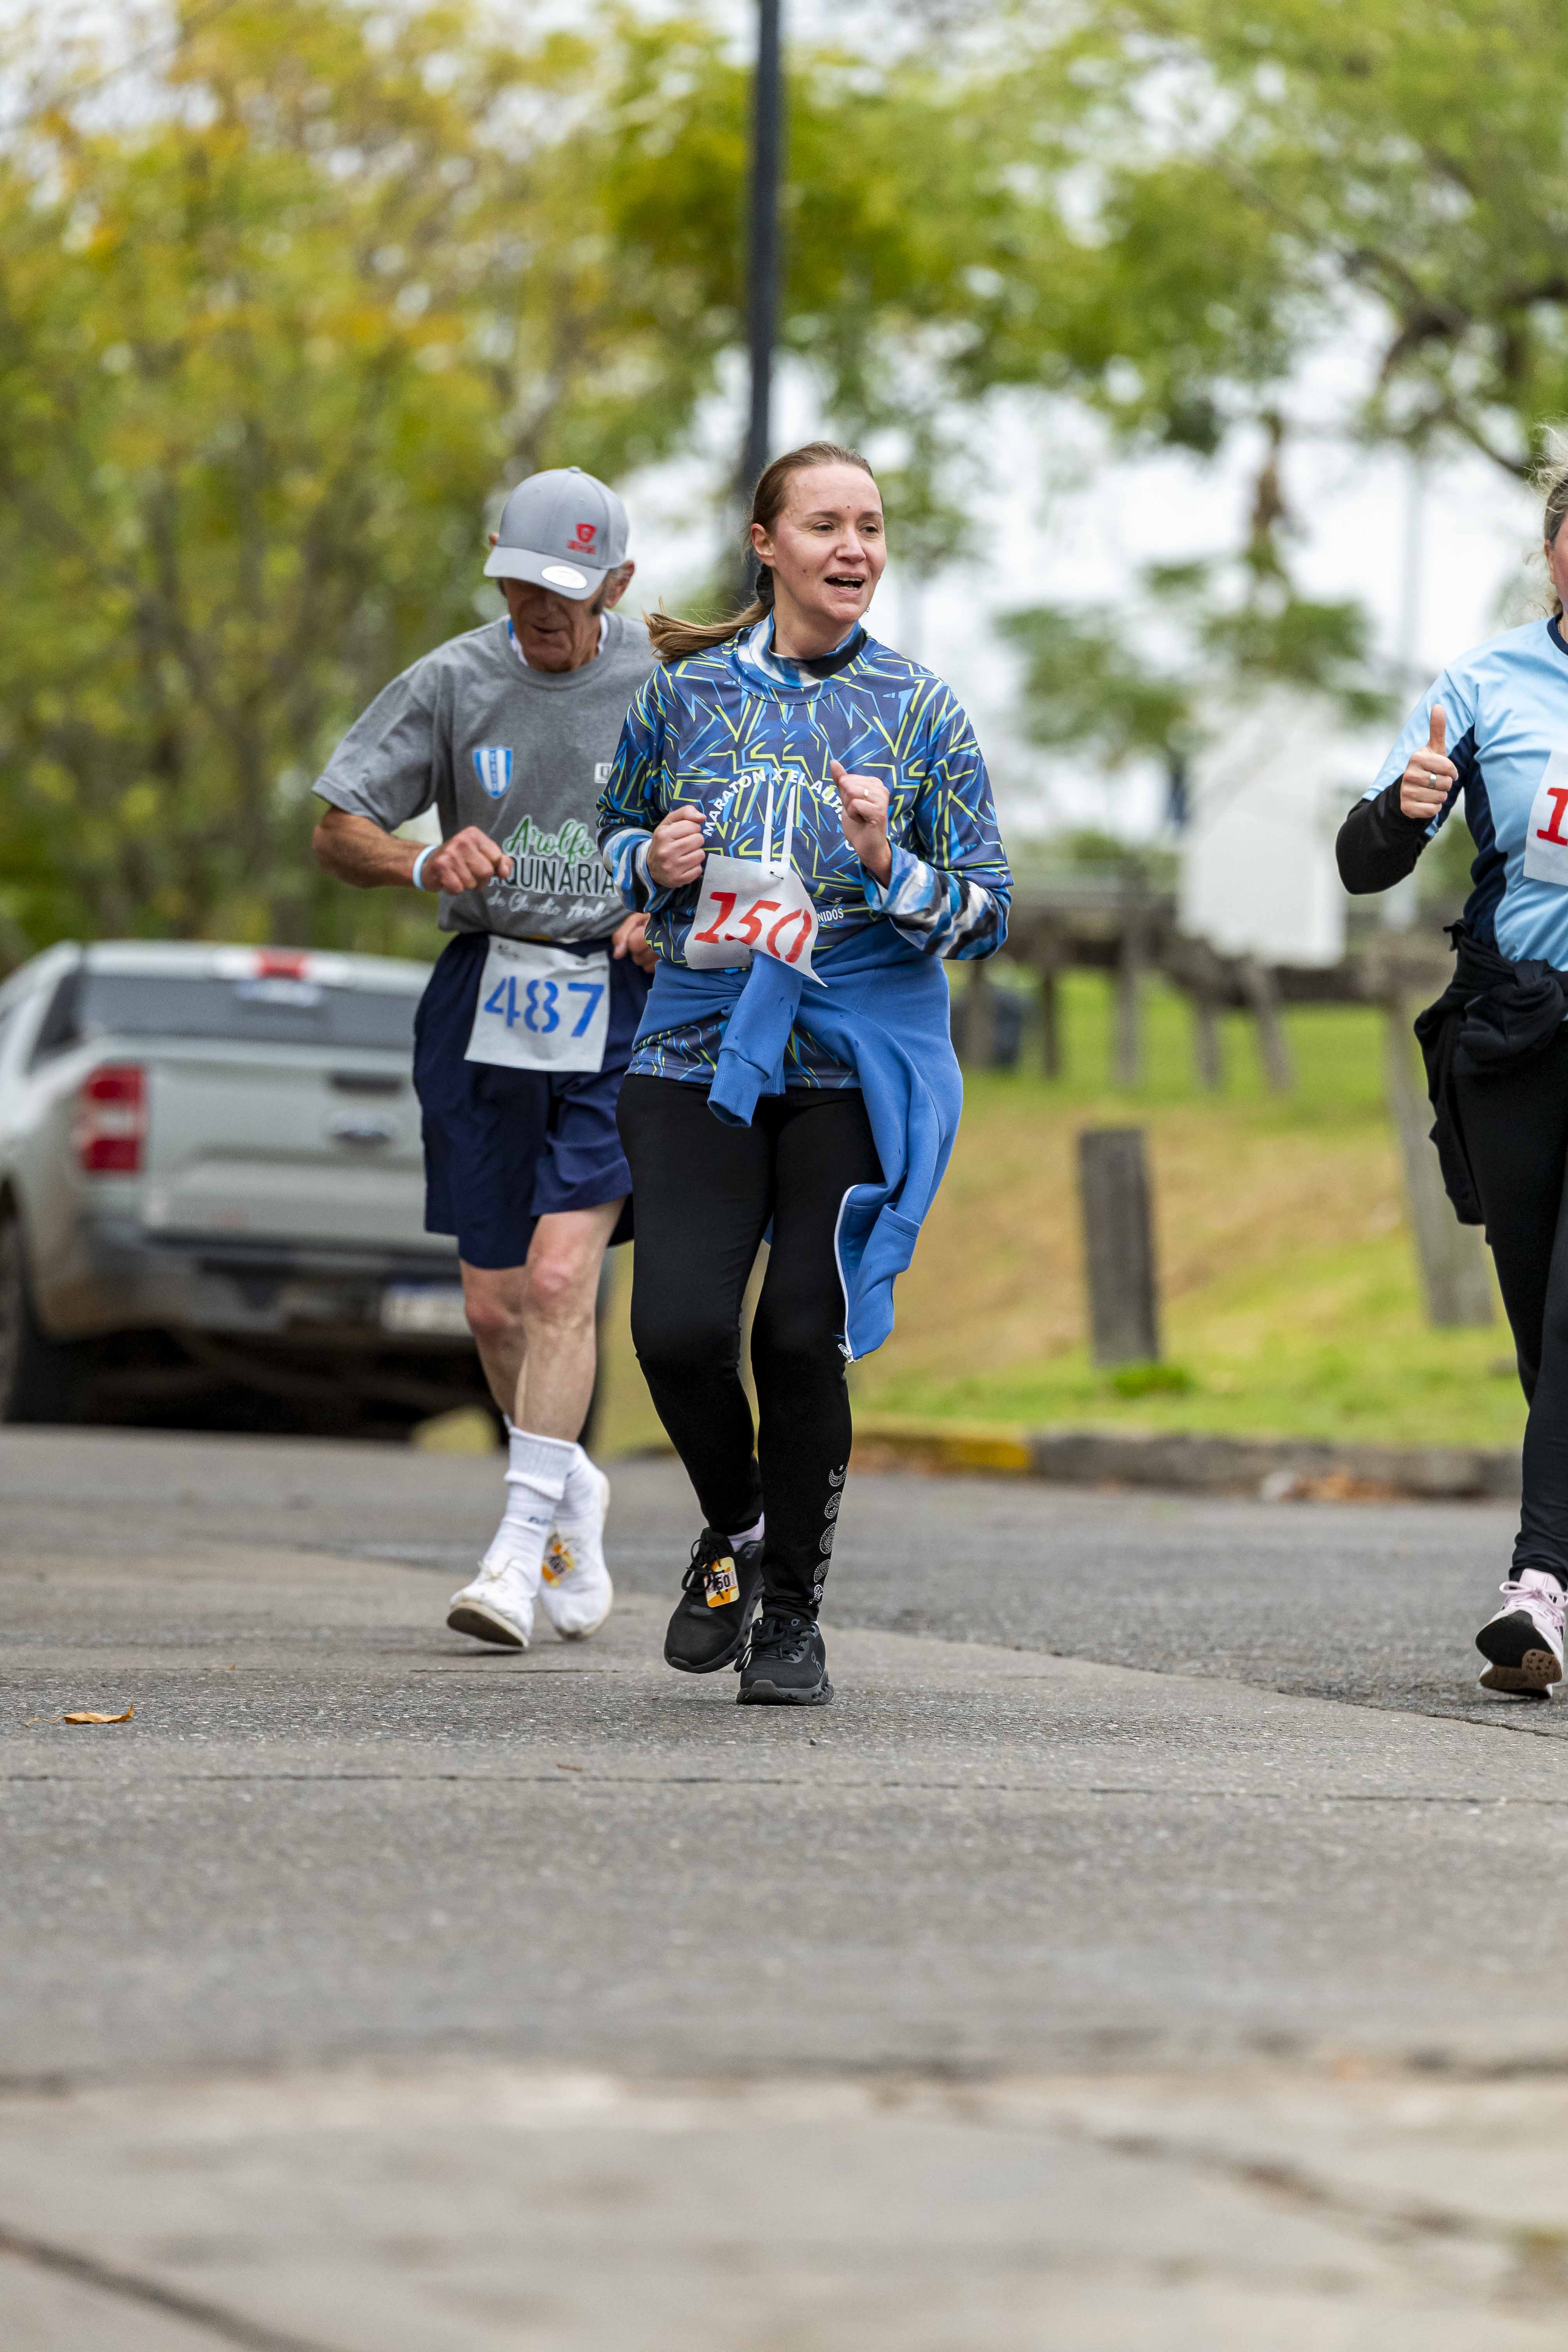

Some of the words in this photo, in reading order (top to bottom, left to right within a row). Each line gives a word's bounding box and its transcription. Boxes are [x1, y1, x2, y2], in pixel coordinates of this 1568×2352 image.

[703, 770, 766, 837] MARATÓN
[772, 768, 784, 781] X
[789, 770, 806, 786] EL
[505, 816, 596, 866] Arolfo
[489, 856, 616, 896] QUINARIA
[694, 891, 812, 963] 150
[817, 908, 844, 922] NIDOS
[483, 976, 604, 1038] 487
